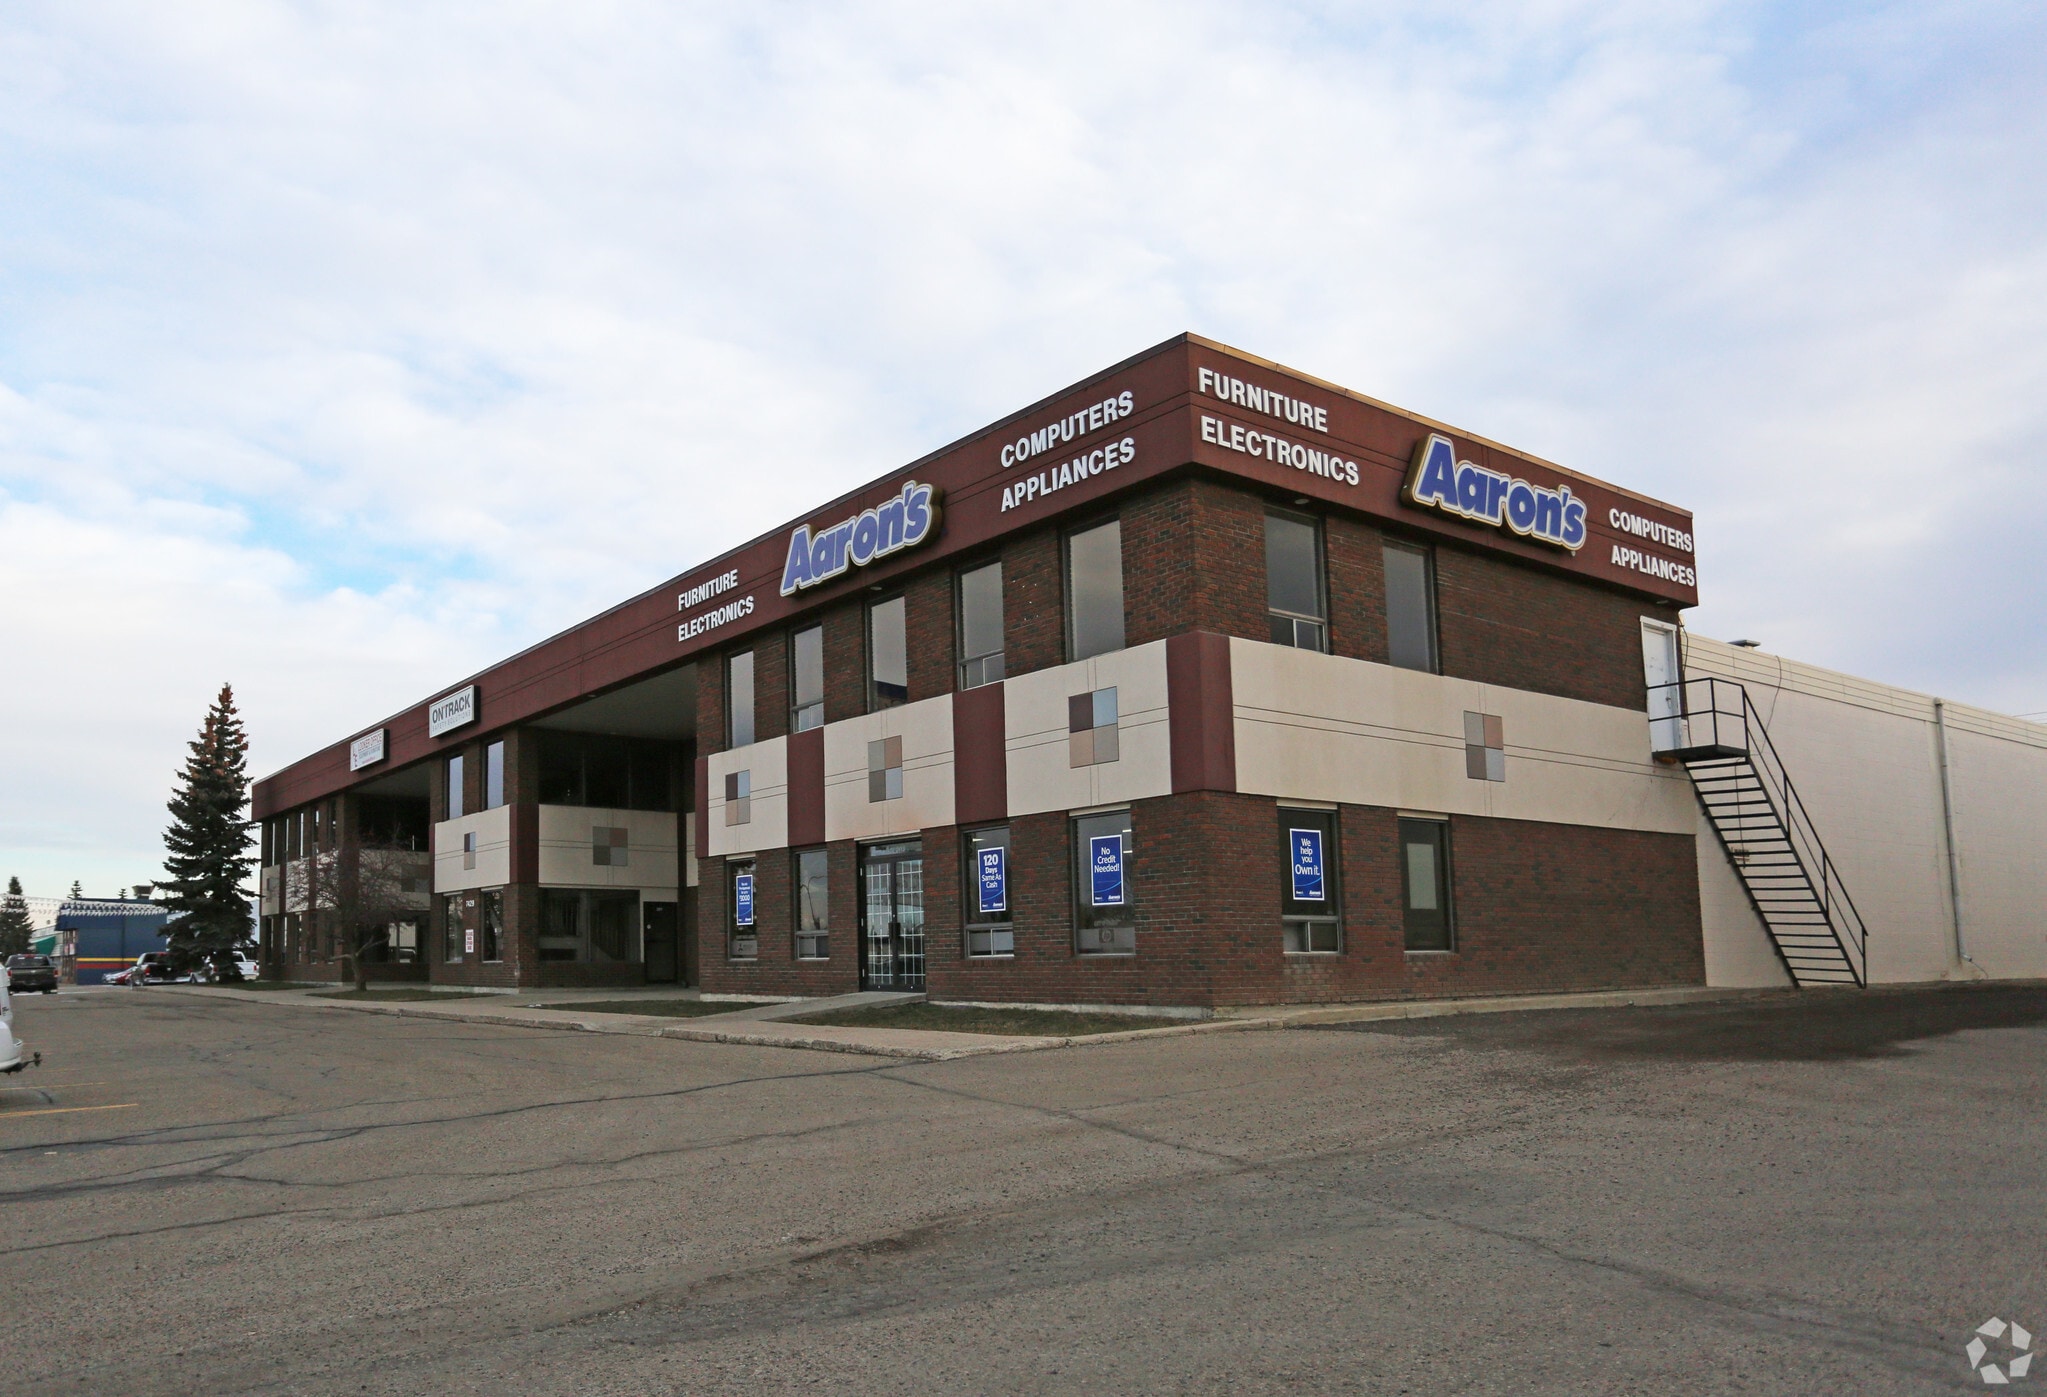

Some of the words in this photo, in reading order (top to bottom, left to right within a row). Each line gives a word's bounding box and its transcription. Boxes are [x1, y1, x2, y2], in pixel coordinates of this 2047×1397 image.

[1198, 367, 1328, 433] FURNITURE
[1001, 391, 1134, 467] COMPUTERS
[1201, 416, 1360, 486] ELECTRONICS
[1001, 438, 1136, 512] APPLIANCES
[1412, 433, 1587, 550] Aaron's
[780, 480, 934, 596] Aaron's
[1609, 508, 1694, 553] COMPUTERS
[1611, 545, 1696, 587] APPLIANCES
[678, 569, 738, 611] FURNITURE
[678, 596, 755, 642] ELECTRONICS
[1101, 847, 1111, 856] No
[1300, 846, 1313, 856] help
[1301, 838, 1312, 847] We
[983, 853, 999, 867] 120
[1094, 863, 1120, 873] Needed!
[1097, 855, 1116, 864] Credit
[1295, 864, 1313, 875] Own
[1301, 856, 1313, 864] you
[981, 874, 995, 882] Same
[995, 873, 1002, 881] As
[985, 881, 998, 889] Cash
